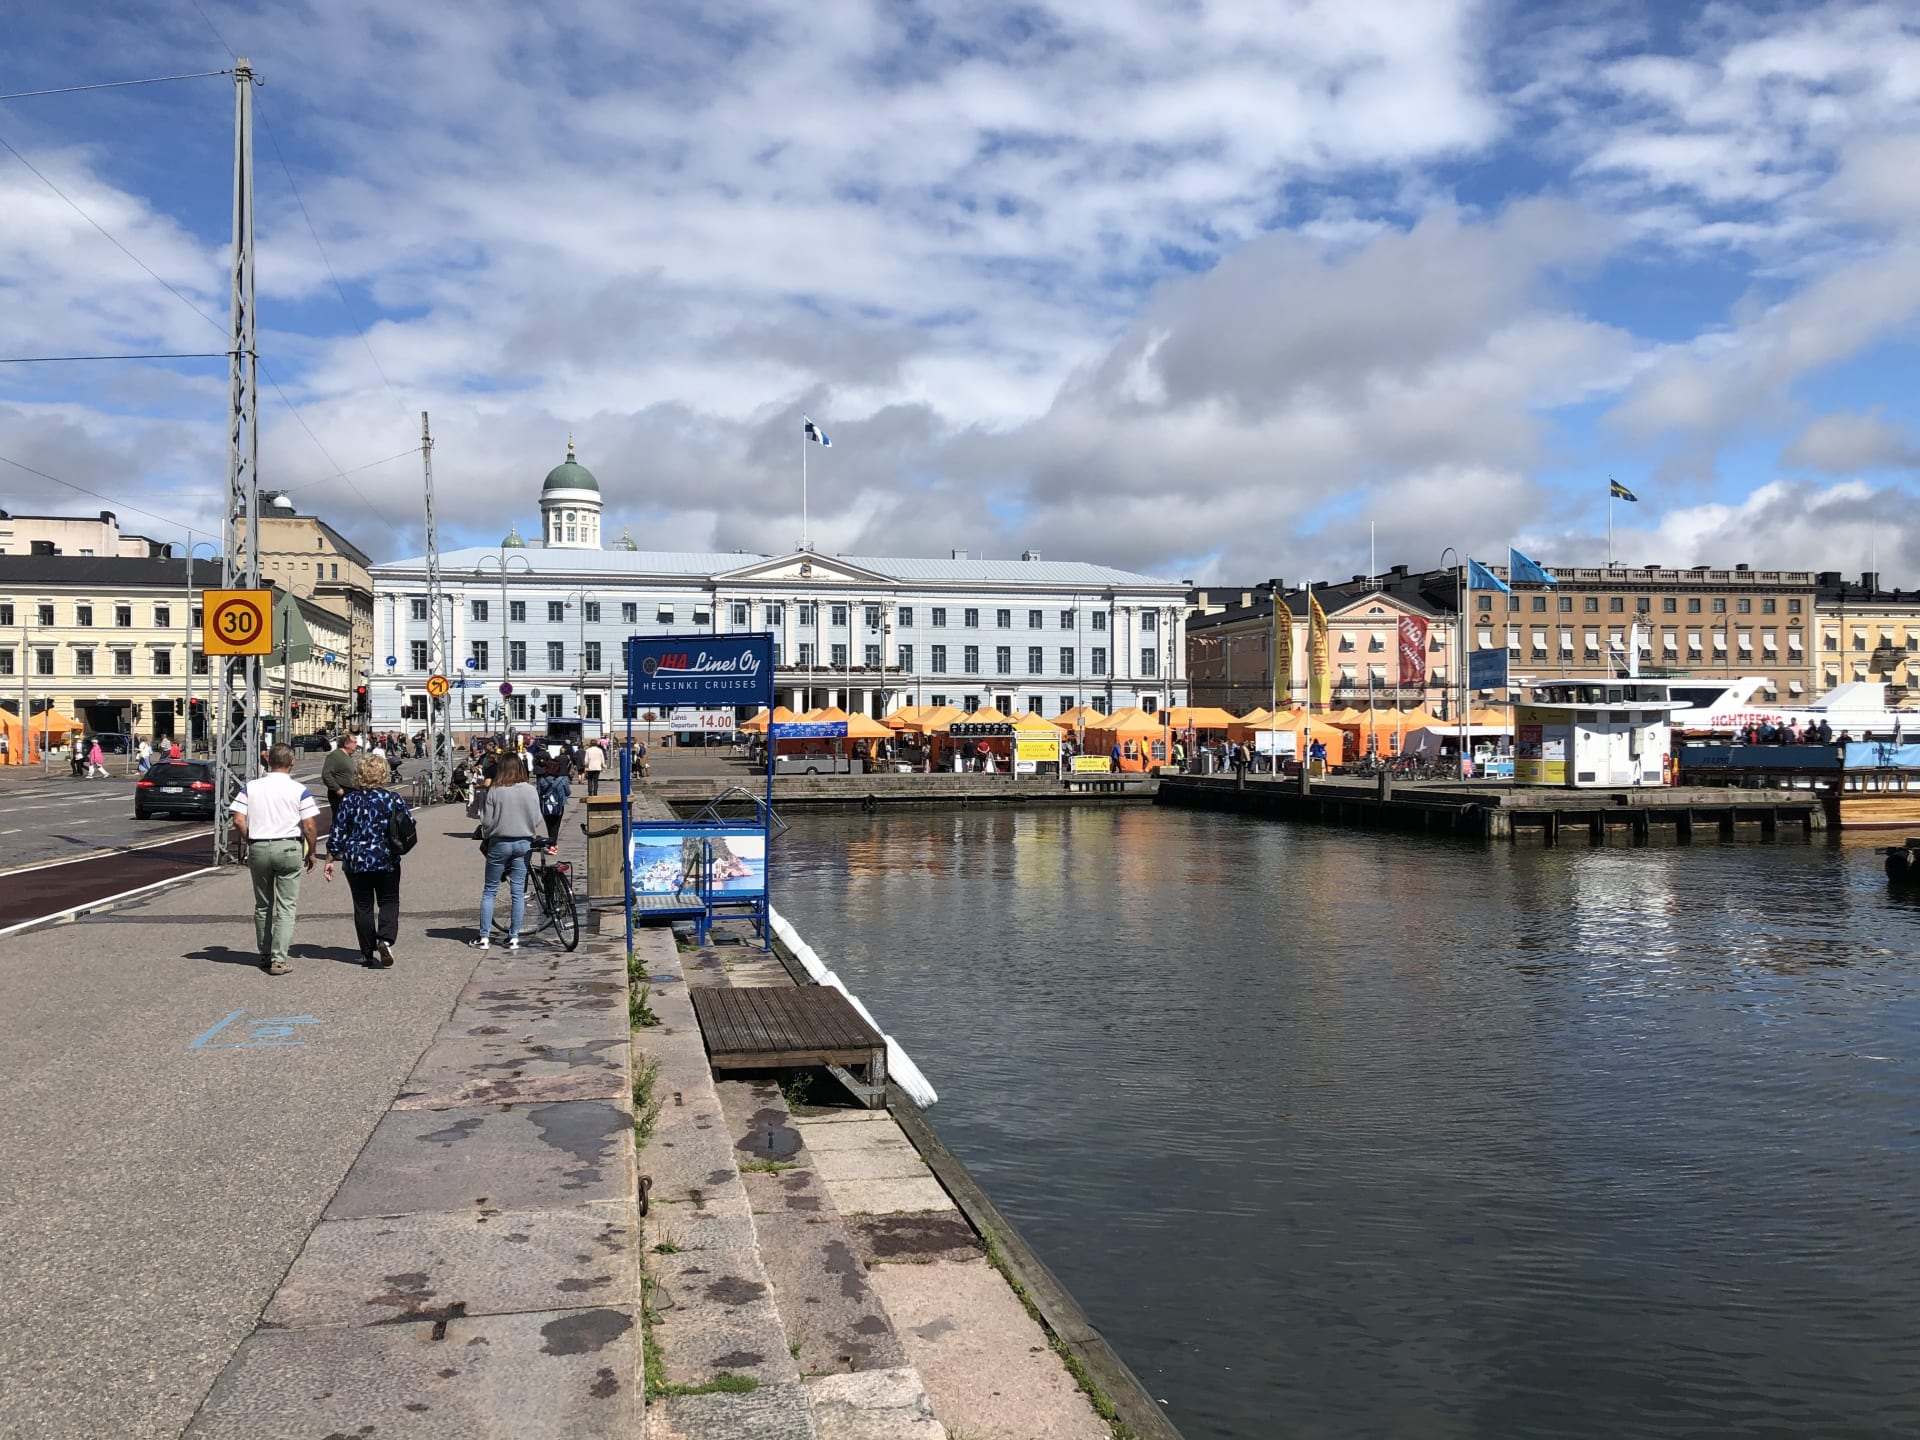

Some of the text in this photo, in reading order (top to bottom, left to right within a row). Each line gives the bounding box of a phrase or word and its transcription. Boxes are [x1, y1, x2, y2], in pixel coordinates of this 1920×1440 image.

[224, 612, 252, 633] 30
[739, 650, 760, 676] Oy
[643, 680, 756, 690] HELSINKI CRUISES
[699, 714, 732, 728] 14.00
